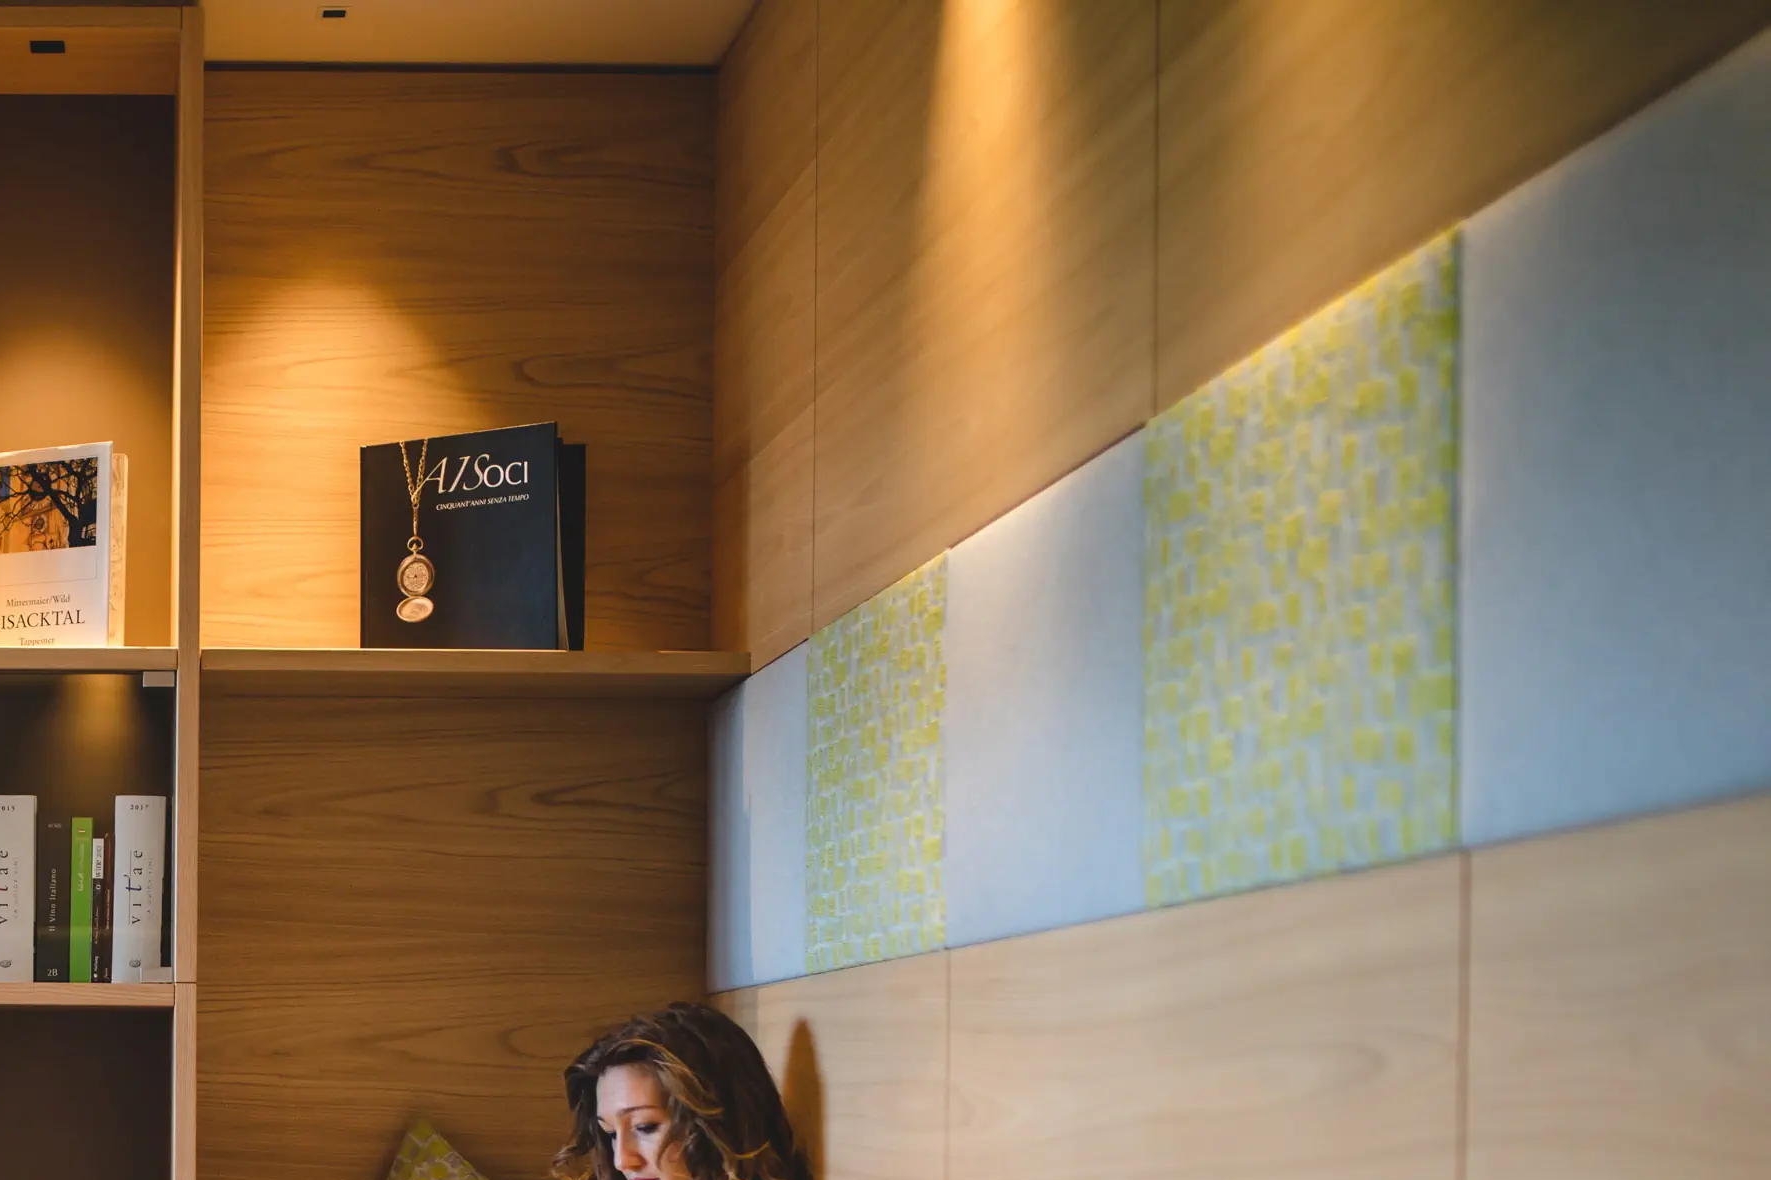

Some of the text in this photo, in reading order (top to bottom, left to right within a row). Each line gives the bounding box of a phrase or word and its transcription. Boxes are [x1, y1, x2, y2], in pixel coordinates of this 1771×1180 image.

[487, 496, 507, 505] SENZA
[508, 494, 529, 502] TEMPO
[48, 868, 57, 900] Italiano
[123, 849, 143, 925] vitae
[49, 903, 57, 923] Vino
[47, 968, 58, 977] 2B
